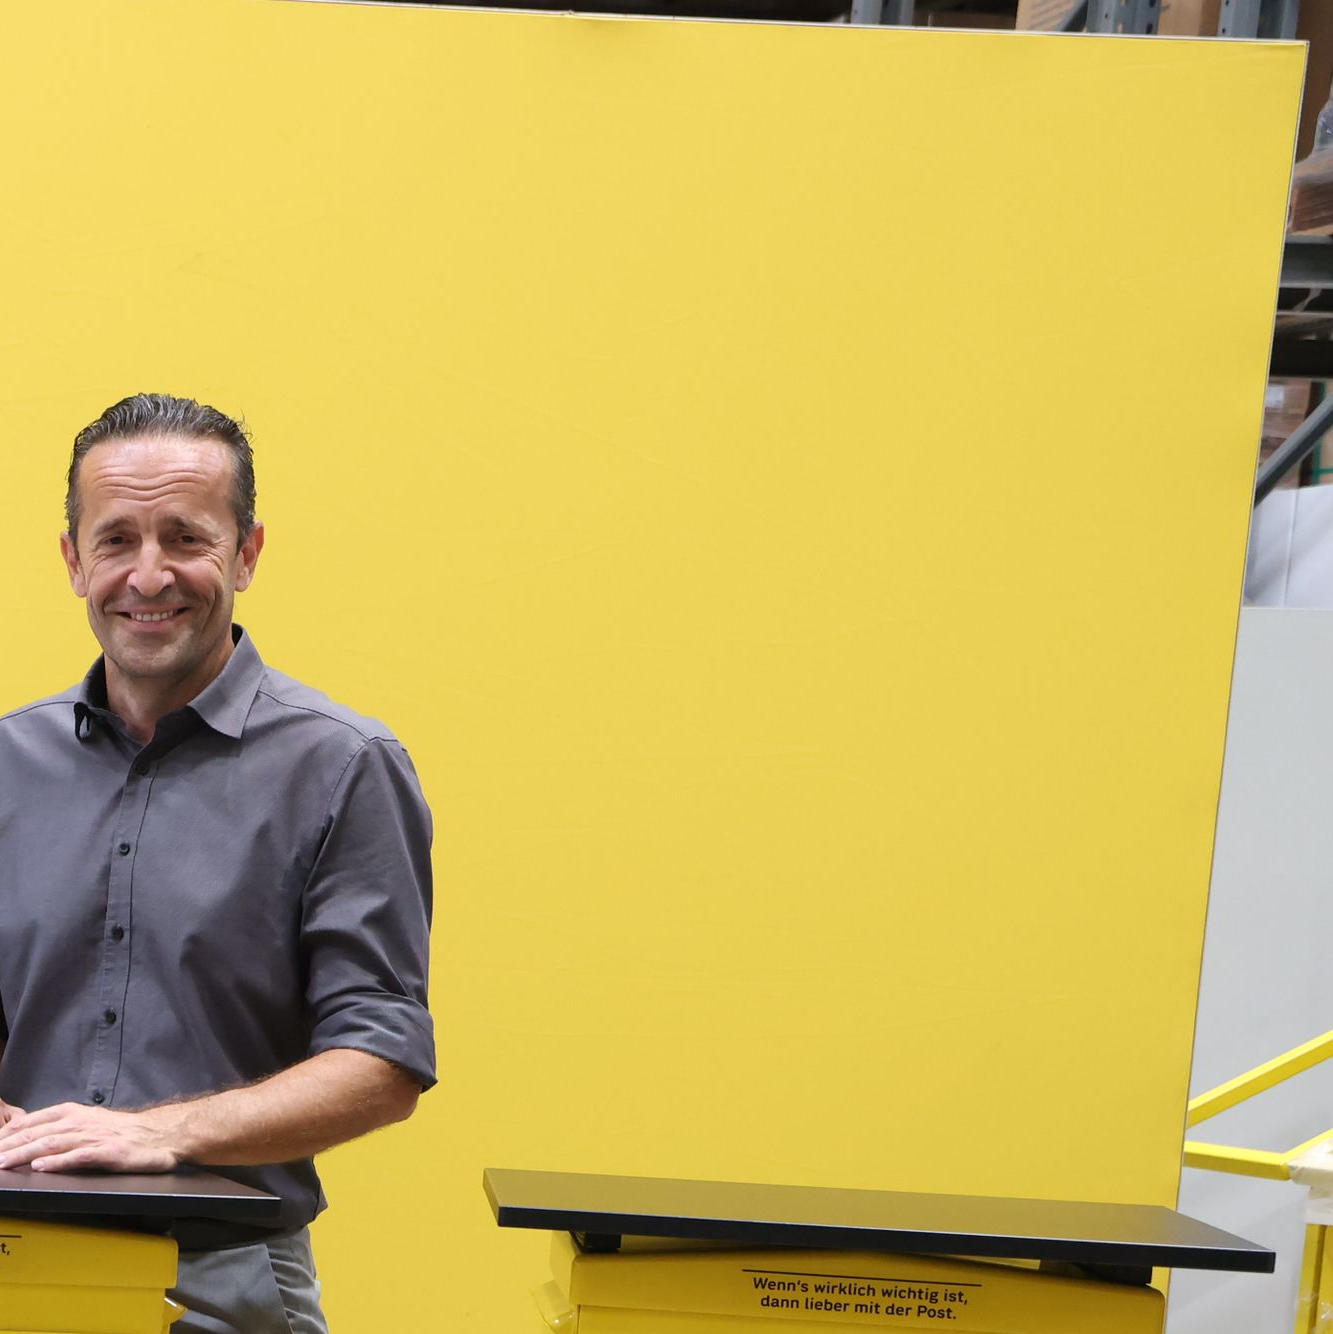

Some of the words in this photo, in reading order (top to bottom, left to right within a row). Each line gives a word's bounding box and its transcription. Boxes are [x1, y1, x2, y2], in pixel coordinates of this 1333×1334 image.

[814, 1282, 875, 1296] wirklich
[881, 1286, 938, 1303] wichtig
[944, 1289, 969, 1305] ist,
[761, 1295, 799, 1308] dann
[805, 1298, 849, 1312] lieber
[855, 1302, 880, 1314] mit
[885, 1303, 912, 1316] der
[917, 1306, 957, 1319] Post.
